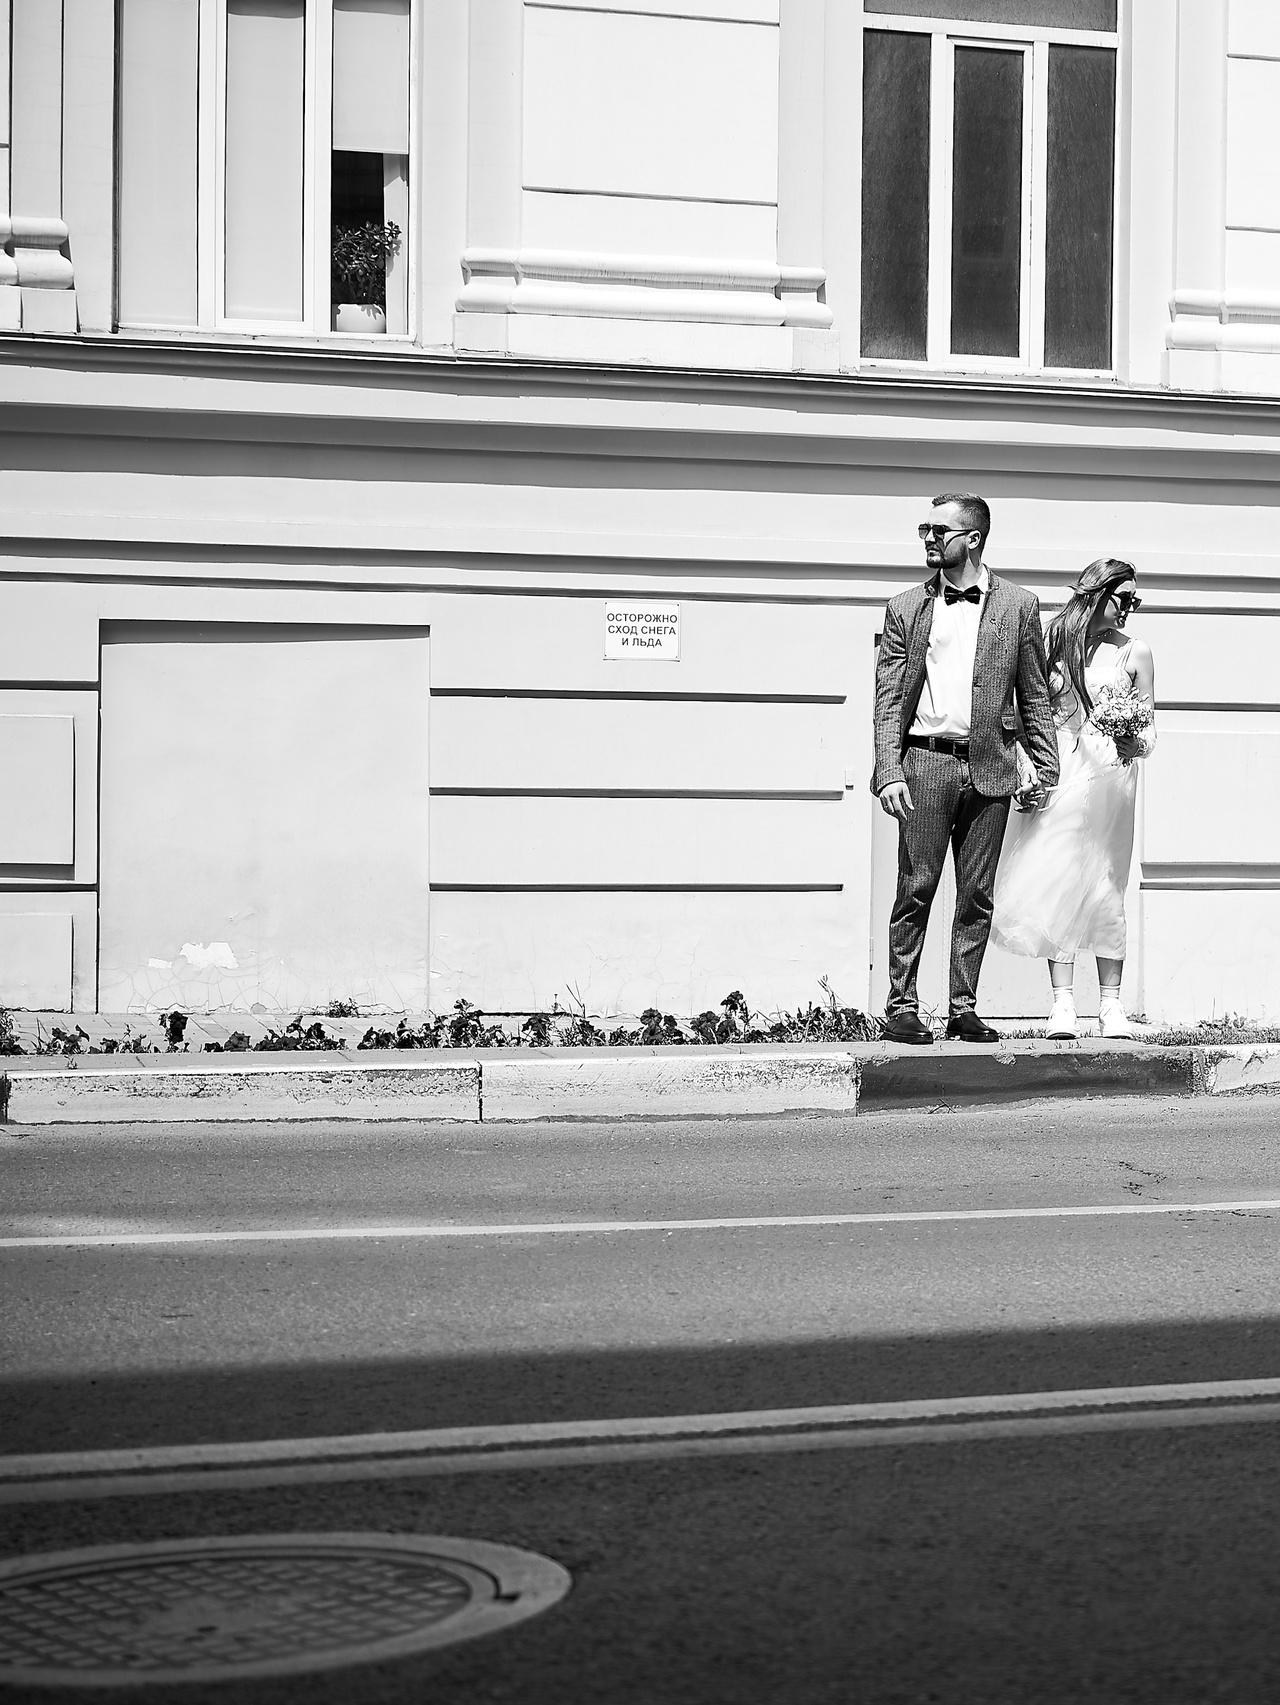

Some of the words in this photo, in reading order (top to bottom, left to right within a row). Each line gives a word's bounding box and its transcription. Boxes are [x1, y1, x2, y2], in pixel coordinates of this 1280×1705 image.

[606, 613, 678, 623] ОСТОРОЖНО
[607, 625, 638, 635] СХОД
[640, 625, 677, 635] СНЕГА
[621, 637, 629, 646] И
[632, 637, 663, 648] ЛЬДА
